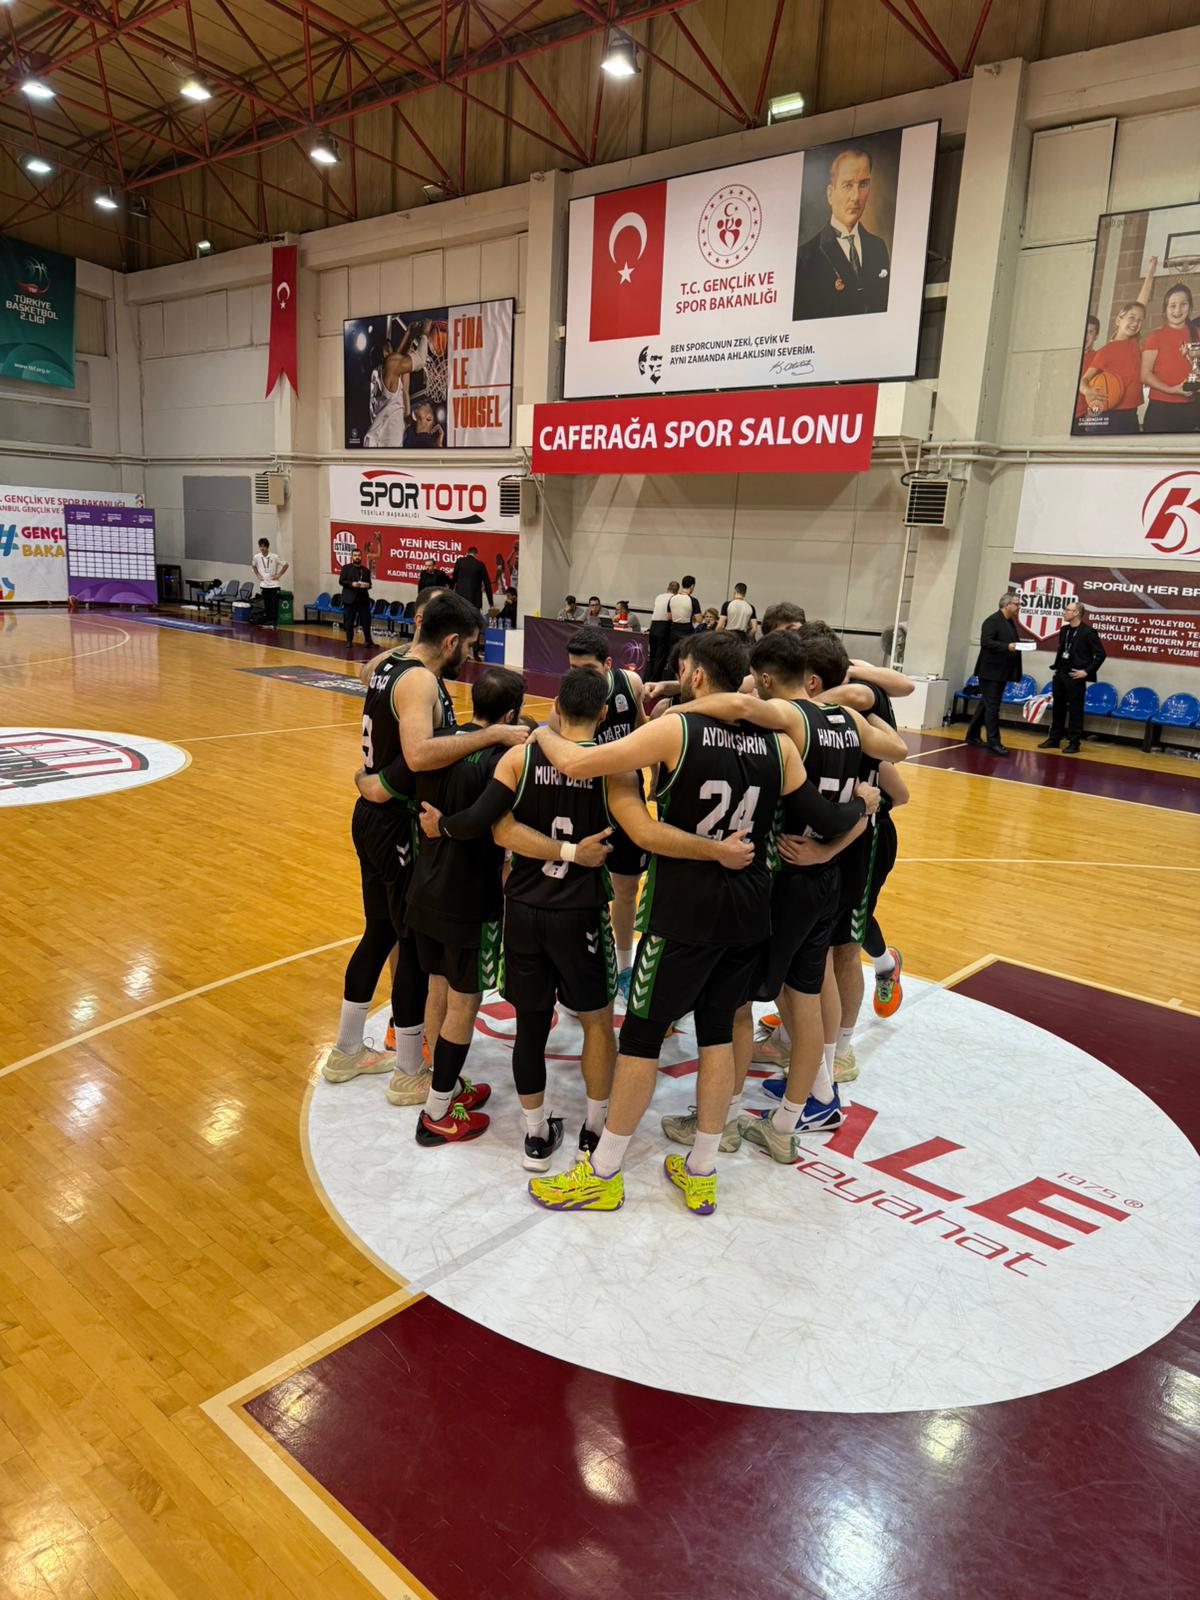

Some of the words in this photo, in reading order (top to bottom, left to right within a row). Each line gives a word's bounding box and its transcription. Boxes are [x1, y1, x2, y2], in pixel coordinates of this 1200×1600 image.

[681, 282, 700, 296] T.C.
[703, 272, 756, 293] GENÇLİK
[758, 271, 775, 285] VE
[6, 300, 58, 320] BASKETBOL
[675, 299, 707, 314] SPOR
[709, 288, 777, 311] BAKANLIĞI
[20, 311, 28, 321] 2.
[453, 314, 483, 351] FİNA
[670, 344, 685, 353] BEN
[686, 340, 732, 352] SPORCUNUN
[734, 335, 753, 347] ZEKİ,
[754, 335, 778, 346] ÇEVİK
[779, 334, 790, 343] VE
[670, 354, 687, 365] AYNI
[687, 352, 726, 364] ZAMANDA
[727, 347, 776, 361] AHLAKLISINI
[777, 344, 816, 357] SEVERİM.
[453, 357, 469, 390] LE
[452, 393, 503, 429] YÜKSEL
[538, 417, 658, 452] CAFERAĞA
[663, 419, 733, 449] SPOR
[738, 413, 864, 446] SALONU
[4, 494, 43, 505] GENÇLİK
[44, 497, 56, 506] VE
[400, 537, 423, 550] YENİ
[424, 539, 462, 552] NESLİN
[390, 550, 440, 562] POTADAKİ
[387, 570, 408, 578] KADIN
[1083, 581, 1143, 593] SPORUN
[1147, 585, 1178, 596] HER
[1088, 613, 1140, 625] BASKETBOL
[1149, 618, 1197, 630] VOLEYBOL
[1092, 622, 1132, 633] BİSİKLET
[1140, 627, 1178, 638] ATICILIK
[1122, 644, 1159, 654] KARATE
[1167, 648, 1199, 658] YÜZME
[1145, 636, 1184, 648] MODERN
[735, 733, 767, 756] ŞİRİN
[696, 780, 761, 842] 24
